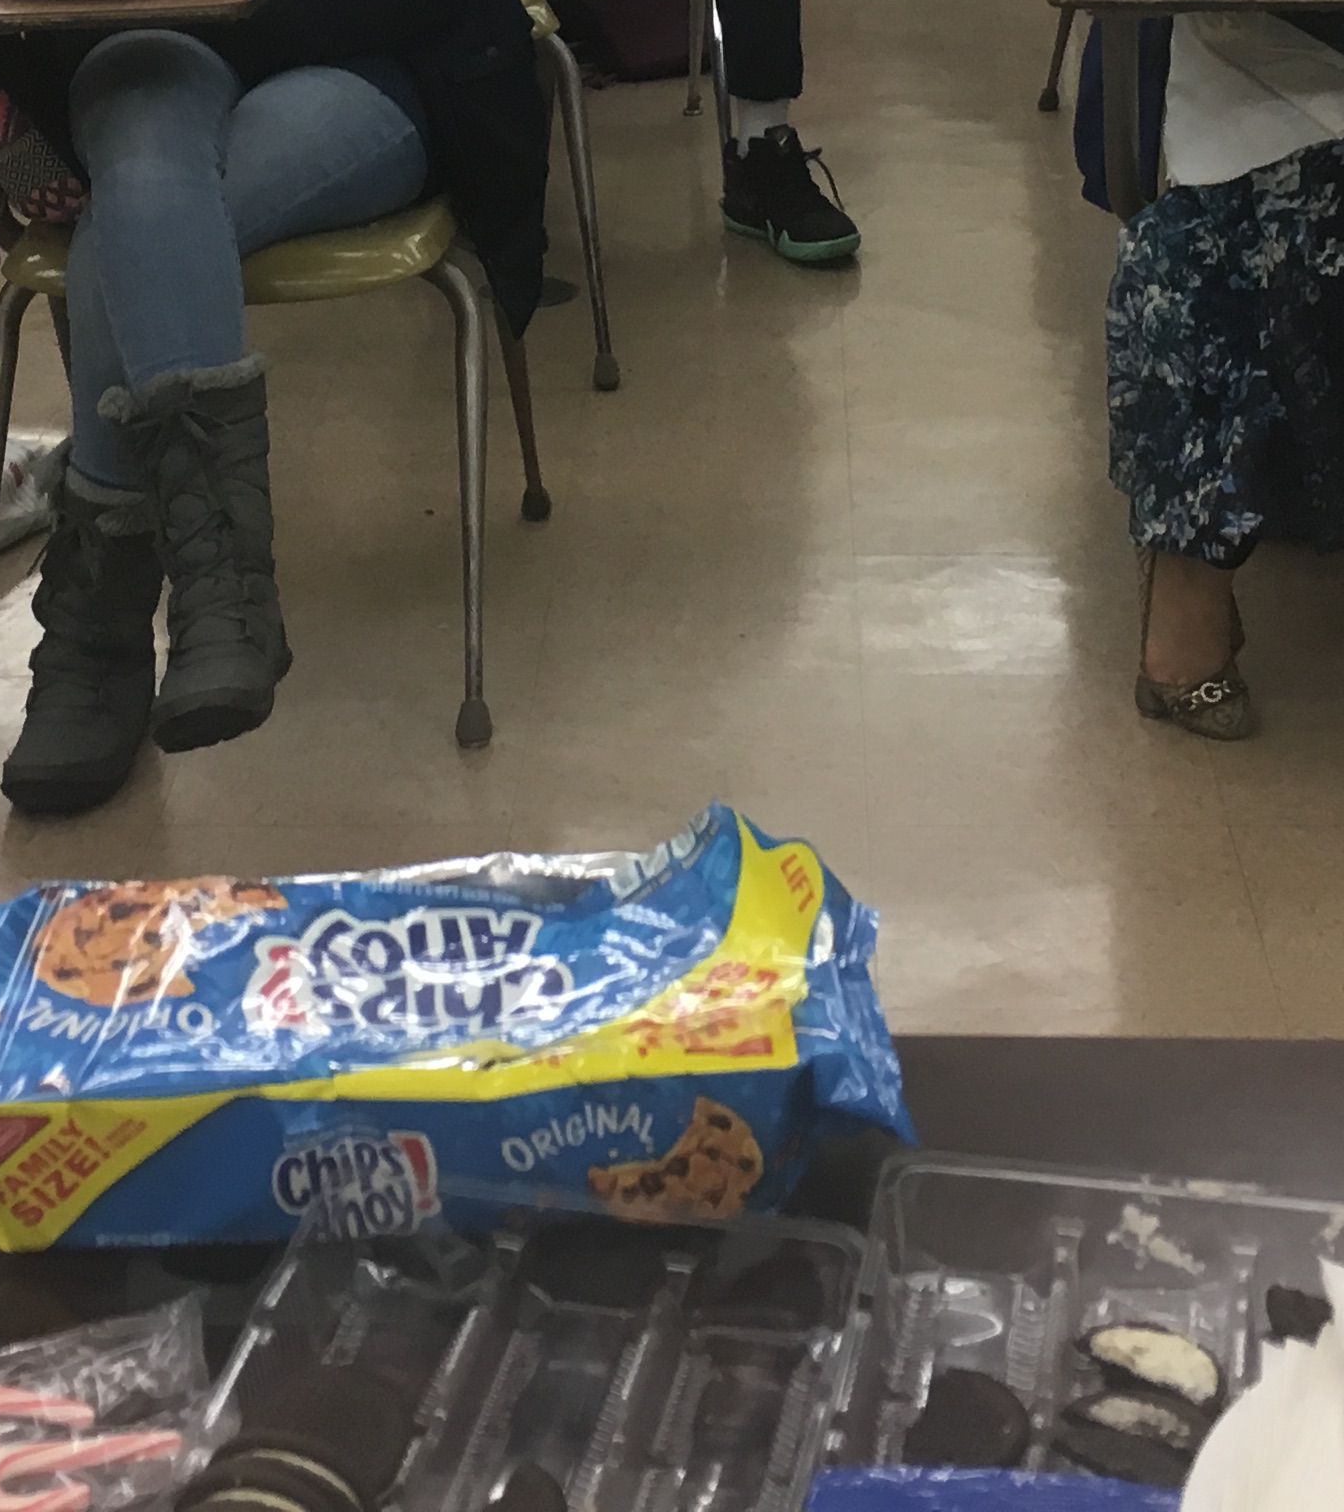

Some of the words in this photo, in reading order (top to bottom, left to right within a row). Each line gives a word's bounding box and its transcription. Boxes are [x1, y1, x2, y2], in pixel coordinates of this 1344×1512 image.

[778, 852, 816, 915] LIFT
[500, 1101, 655, 1173] ORIGINAL
[9, 1136, 111, 1228] SIZE!
[276, 1140, 405, 1208] Chips
